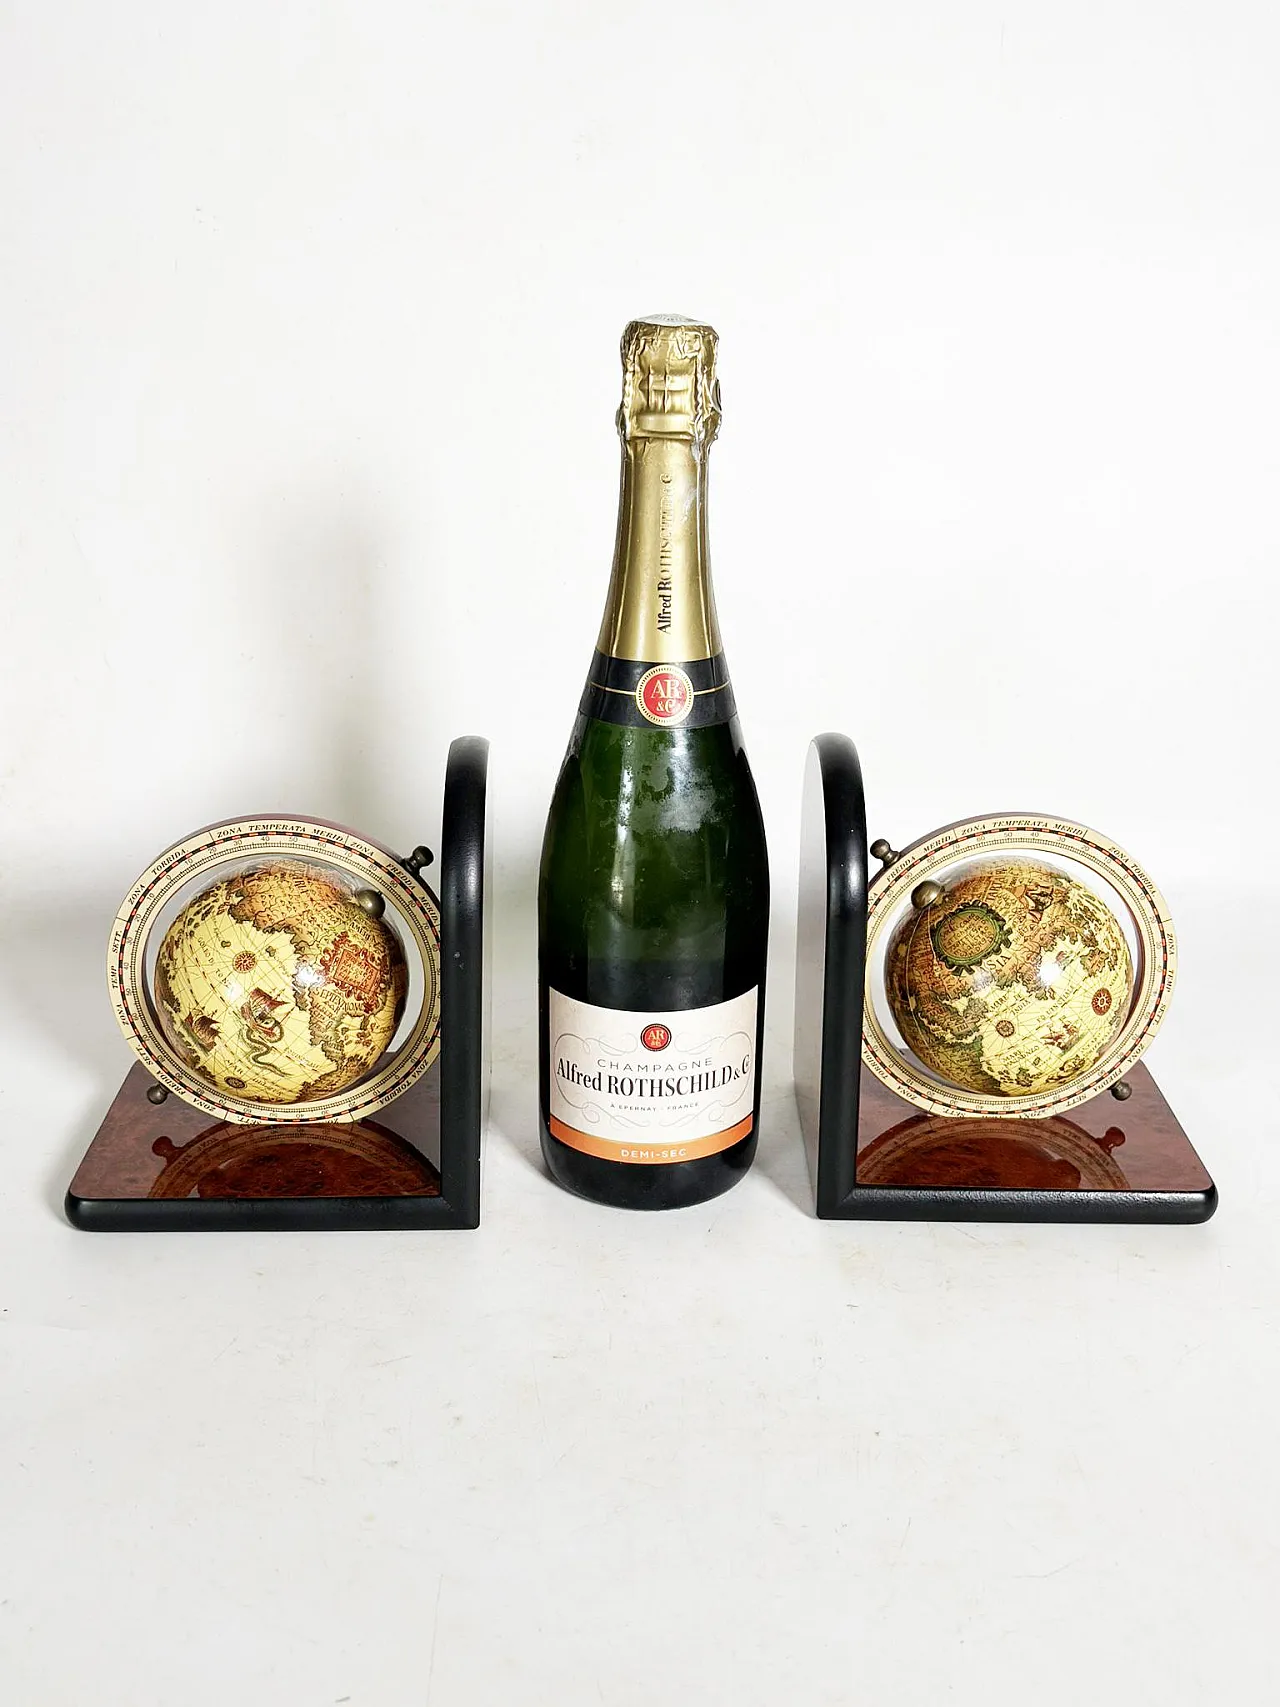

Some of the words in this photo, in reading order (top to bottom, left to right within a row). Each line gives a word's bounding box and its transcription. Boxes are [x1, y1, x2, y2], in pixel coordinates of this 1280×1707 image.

[657, 594, 672, 635] Alfred
[650, 679, 683, 699] AR
[217, 827, 242, 839] ZONA
[248, 824, 306, 833] TEMPERATA
[961, 824, 986, 836] ZONA
[992, 820, 1048, 828] TEMPERATA
[1108, 846, 1129, 863] ZONA
[350, 841, 374, 857] ZONA
[386, 863, 416, 890] FREDDA
[886, 856, 916, 883] FREDDA
[128, 884, 146, 905] ZONA
[1166, 933, 1175, 955] ZONA
[116, 1003, 129, 1026] ZONA
[1127, 1043, 1145, 1063] ZONA
[412, 1059, 429, 1078] ZONA
[557, 1058, 602, 1091] Alfred
[597, 1056, 713, 1073] CHAMPAGNE
[156, 1070, 186, 1096] FREDDA
[1093, 1069, 1123, 1092] FREDDA
[897, 1085, 918, 1101] ZONA
[192, 1097, 216, 1112] ZONA
[618, 1104, 657, 1112] EPERNAY
[667, 1101, 699, 1110] FRANCE
[621, 1148, 687, 1159] DEMI-SEC
